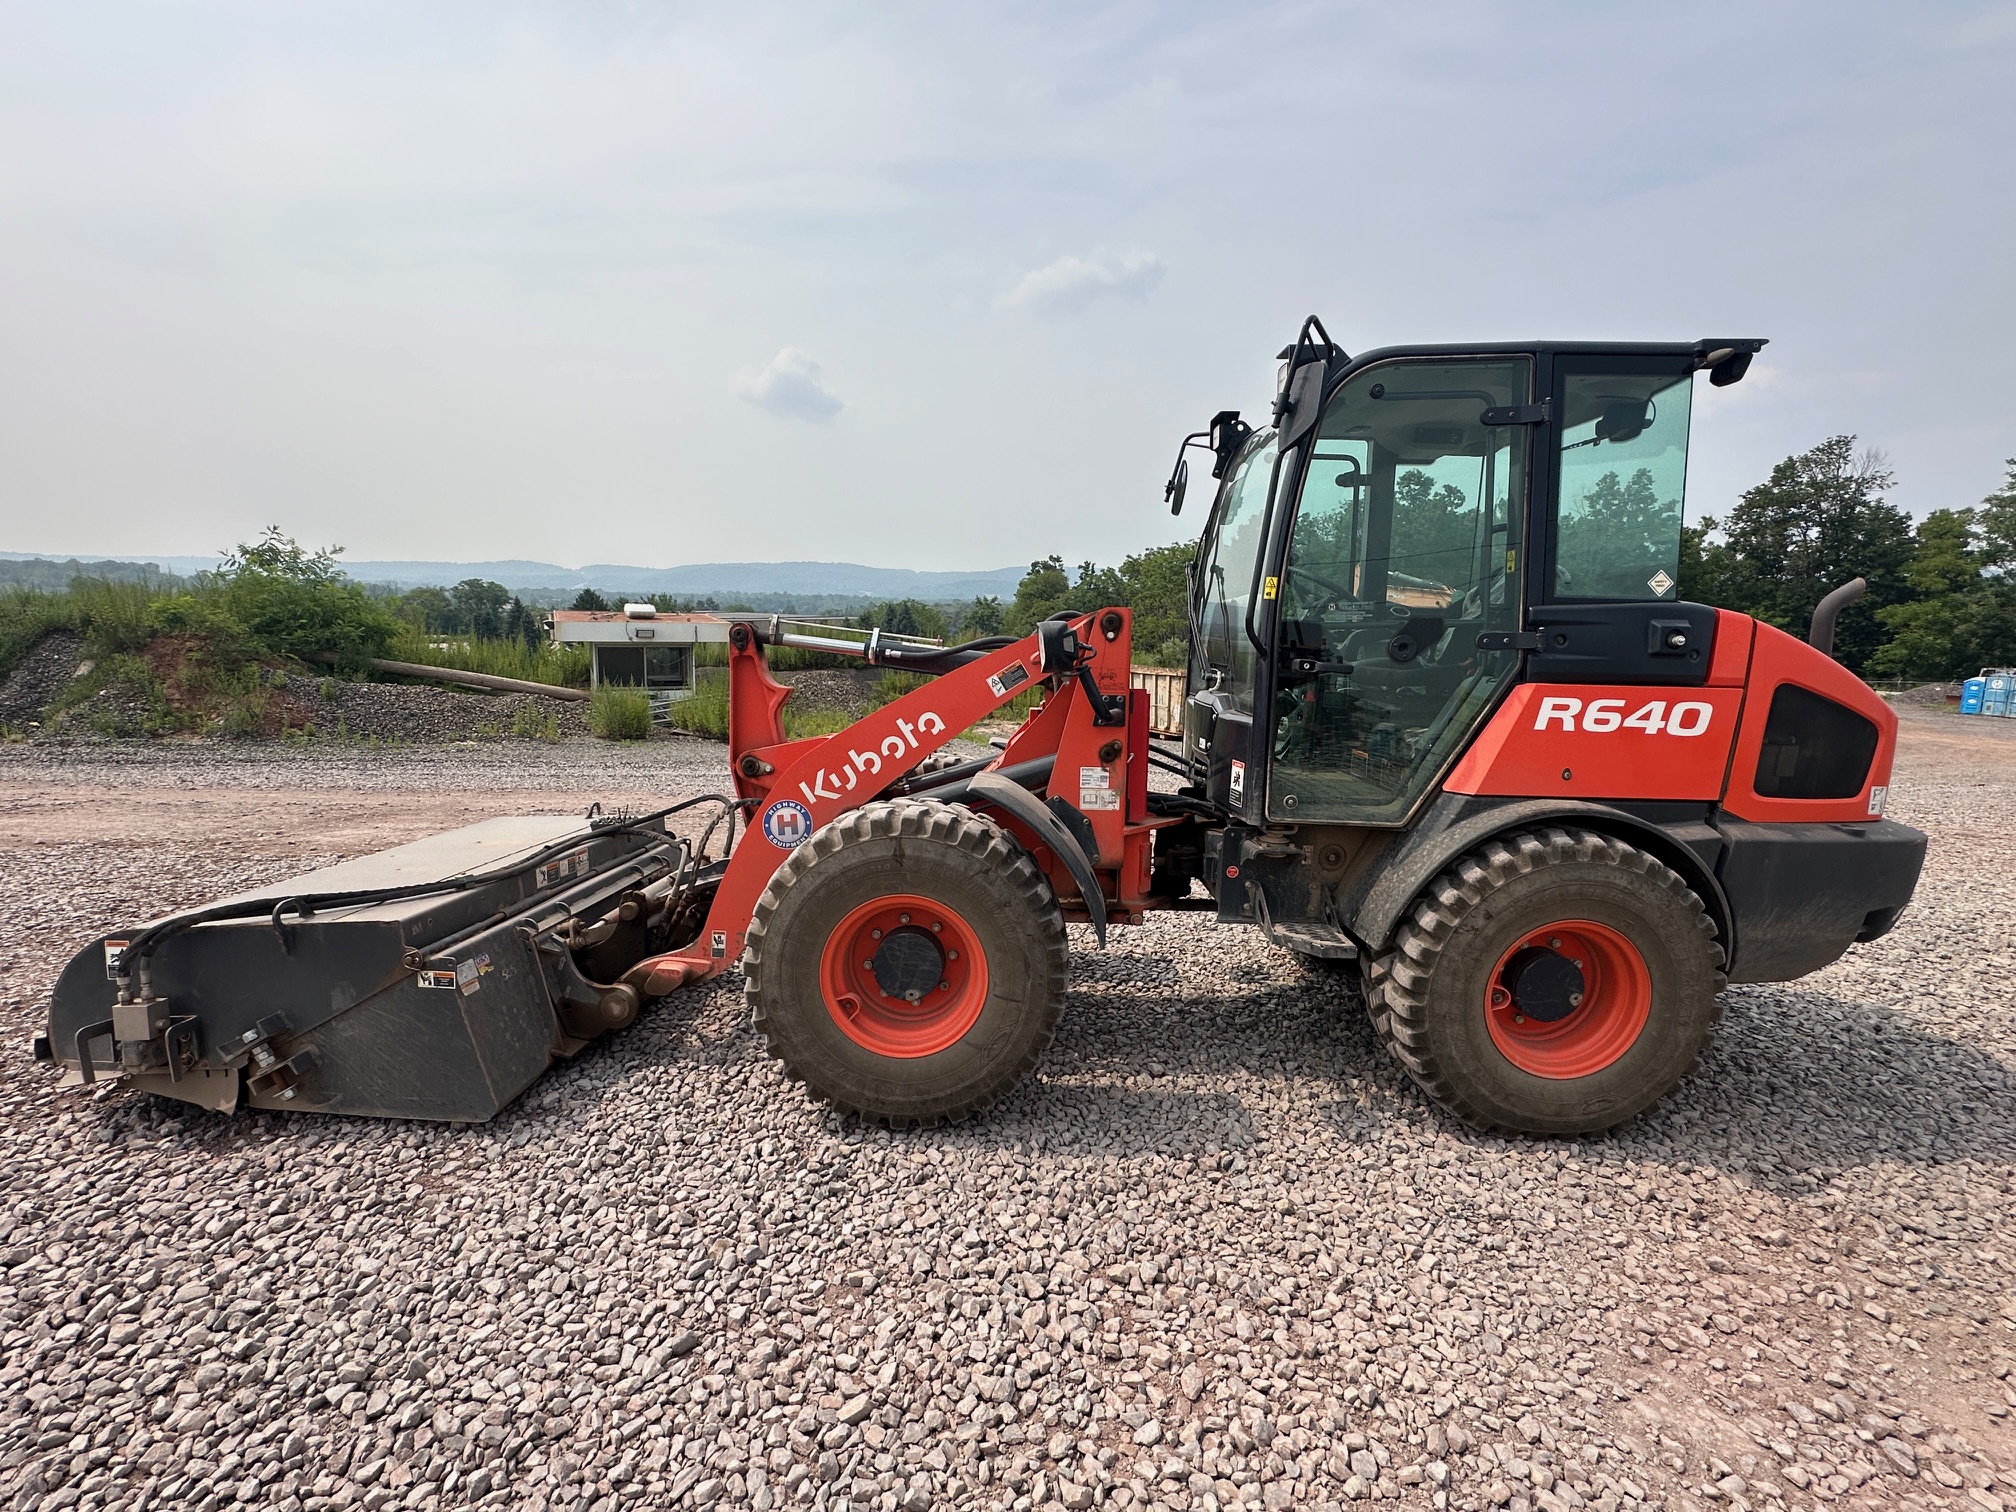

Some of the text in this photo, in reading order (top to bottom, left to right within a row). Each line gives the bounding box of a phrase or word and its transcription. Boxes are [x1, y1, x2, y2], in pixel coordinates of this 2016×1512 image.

[1533, 696, 1713, 737] R640
[798, 711, 946, 805] Kubota
[768, 801, 806, 816] HIGHWAY
[777, 813, 799, 836] H
[768, 832, 808, 848] EQUIPMENT
